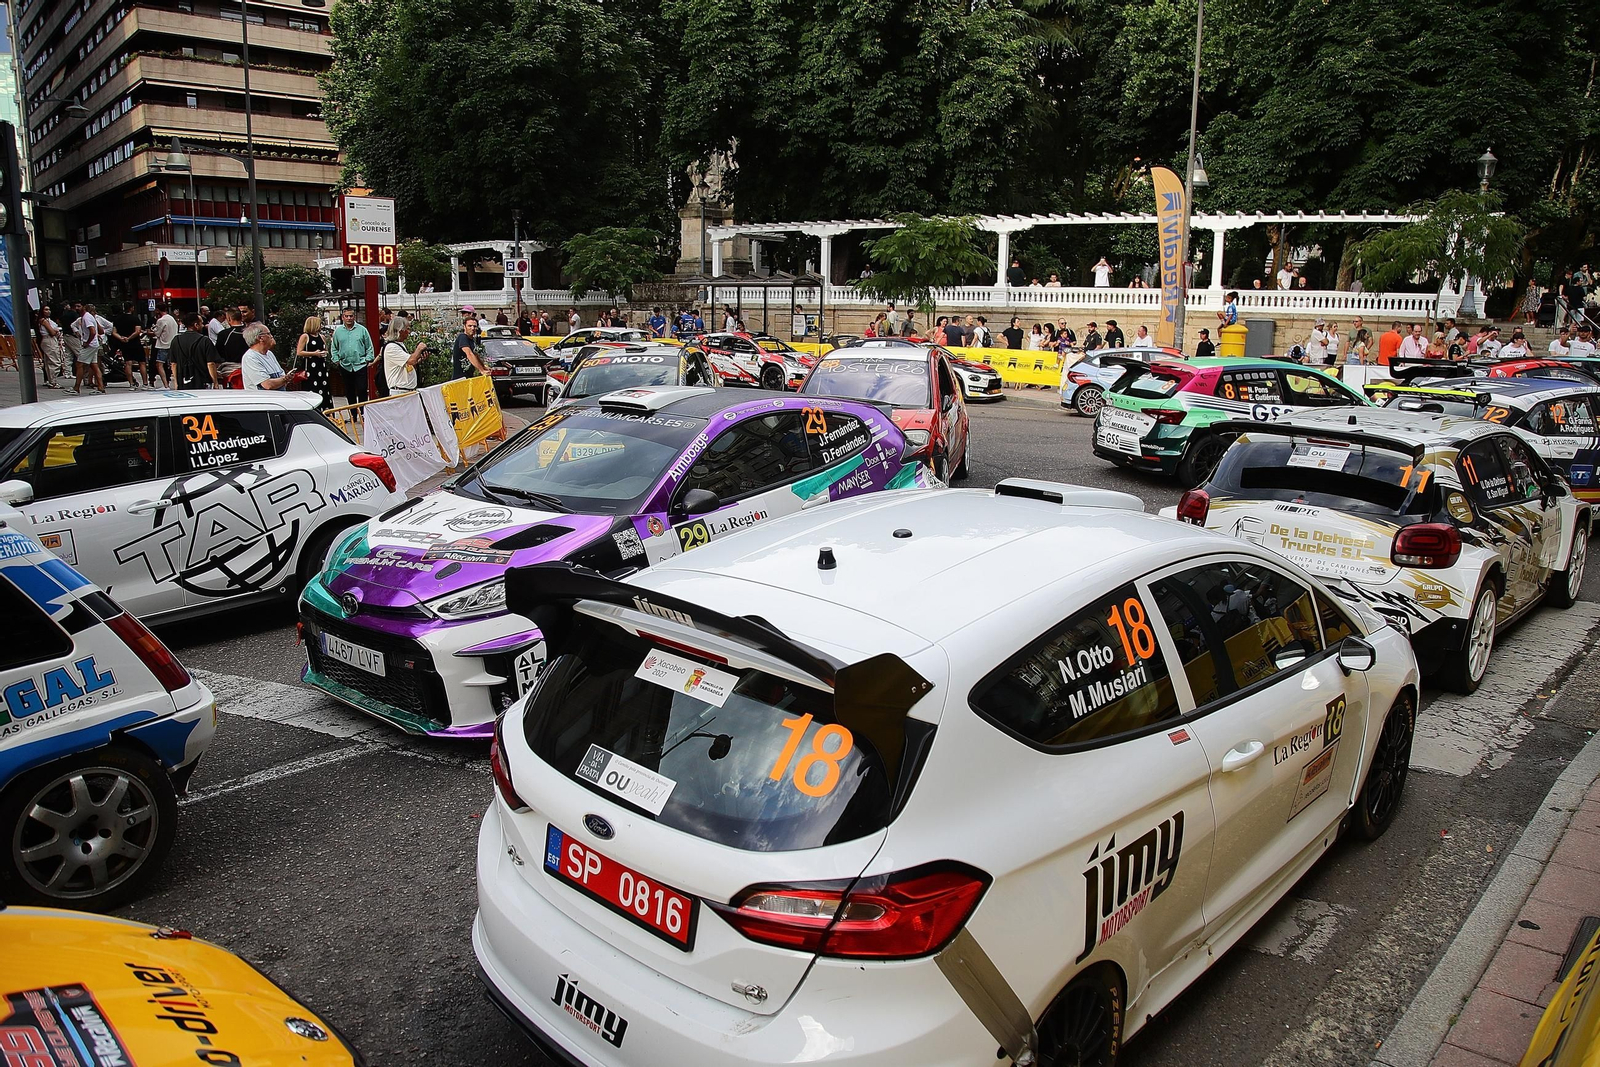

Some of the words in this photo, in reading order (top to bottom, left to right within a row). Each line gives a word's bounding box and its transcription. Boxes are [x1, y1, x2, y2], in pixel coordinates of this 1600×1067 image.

[361, 225, 391, 233] OURENSE
[348, 245, 394, 265] 20:18
[611, 356, 665, 364] MOTO
[1224, 383, 1235, 400] 8
[801, 407, 828, 434] 29
[1482, 405, 1509, 424] 12
[1550, 404, 1566, 424] 12
[182, 414, 219, 443] 34
[819, 418, 860, 447] J.Fernández
[1111, 421, 1137, 432] MICHELIN
[189, 433, 267, 455] J.M.Rodríguez
[822, 434, 867, 464] D.Fernández
[1106, 432, 1120, 446] GSS
[191, 451, 240, 468] I.López
[668, 431, 710, 482] Amboage
[1399, 465, 1432, 494] 11
[1462, 455, 1479, 485] 11
[1571, 471, 1591, 479] RTS
[342, 476, 366, 492] CARNES
[31, 513, 56, 525] La
[57, 502, 118, 520] Región
[709, 520, 728, 535] La
[728, 508, 769, 531] Región
[1297, 507, 1320, 517] PTC
[113, 468, 327, 586] TAR
[680, 523, 708, 551] 29
[1270, 523, 1289, 536] De
[1294, 527, 1308, 540] la
[1313, 530, 1375, 549] Dehesa
[1281, 537, 1337, 557] Trucks
[343, 557, 394, 567] PREMIUM
[397, 560, 434, 572] CARS
[1330, 562, 1370, 575] CAMIONES
[1422, 583, 1443, 592] GRUPO
[1107, 597, 1155, 667] 18
[327, 636, 353, 661] 4467
[359, 645, 379, 673] LVF
[1057, 645, 1114, 684] N.Otto
[652, 668, 668, 679] 2027
[1068, 661, 1147, 718] M.Musiari
[26, 697, 98, 728] GALLEGAS,
[101, 687, 124, 699] S.L.
[1326, 700, 1345, 741] 18
[769, 712, 854, 797] 18
[1273, 745, 1288, 766] La
[1290, 722, 1323, 755] Región
[579, 764, 600, 780] PRATA
[588, 818, 610, 837] Ford
[547, 852, 560, 867] EST
[567, 843, 602, 884] SP
[619, 871, 683, 935] 0816
[1099, 885, 1152, 947] MOTORSPORT
[563, 1003, 601, 1035] MOTORSPORT
